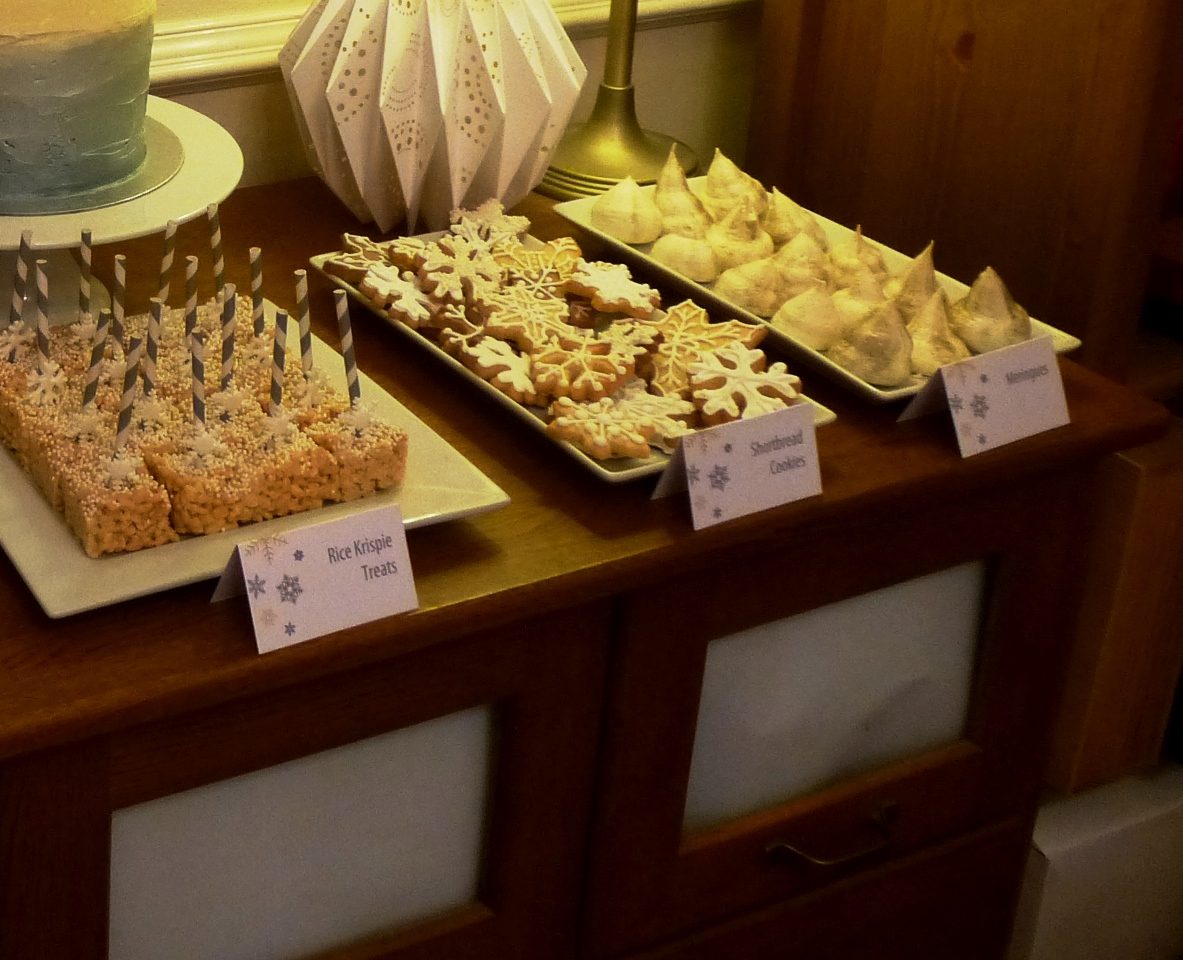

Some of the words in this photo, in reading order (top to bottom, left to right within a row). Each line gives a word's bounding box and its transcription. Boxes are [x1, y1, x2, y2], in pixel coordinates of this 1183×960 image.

[750, 430, 803, 456] Shortbread
[769, 455, 806, 475] Cookies
[327, 545, 353, 564] Rice
[354, 533, 393, 557] Krispie
[361, 559, 398, 581] Treats
